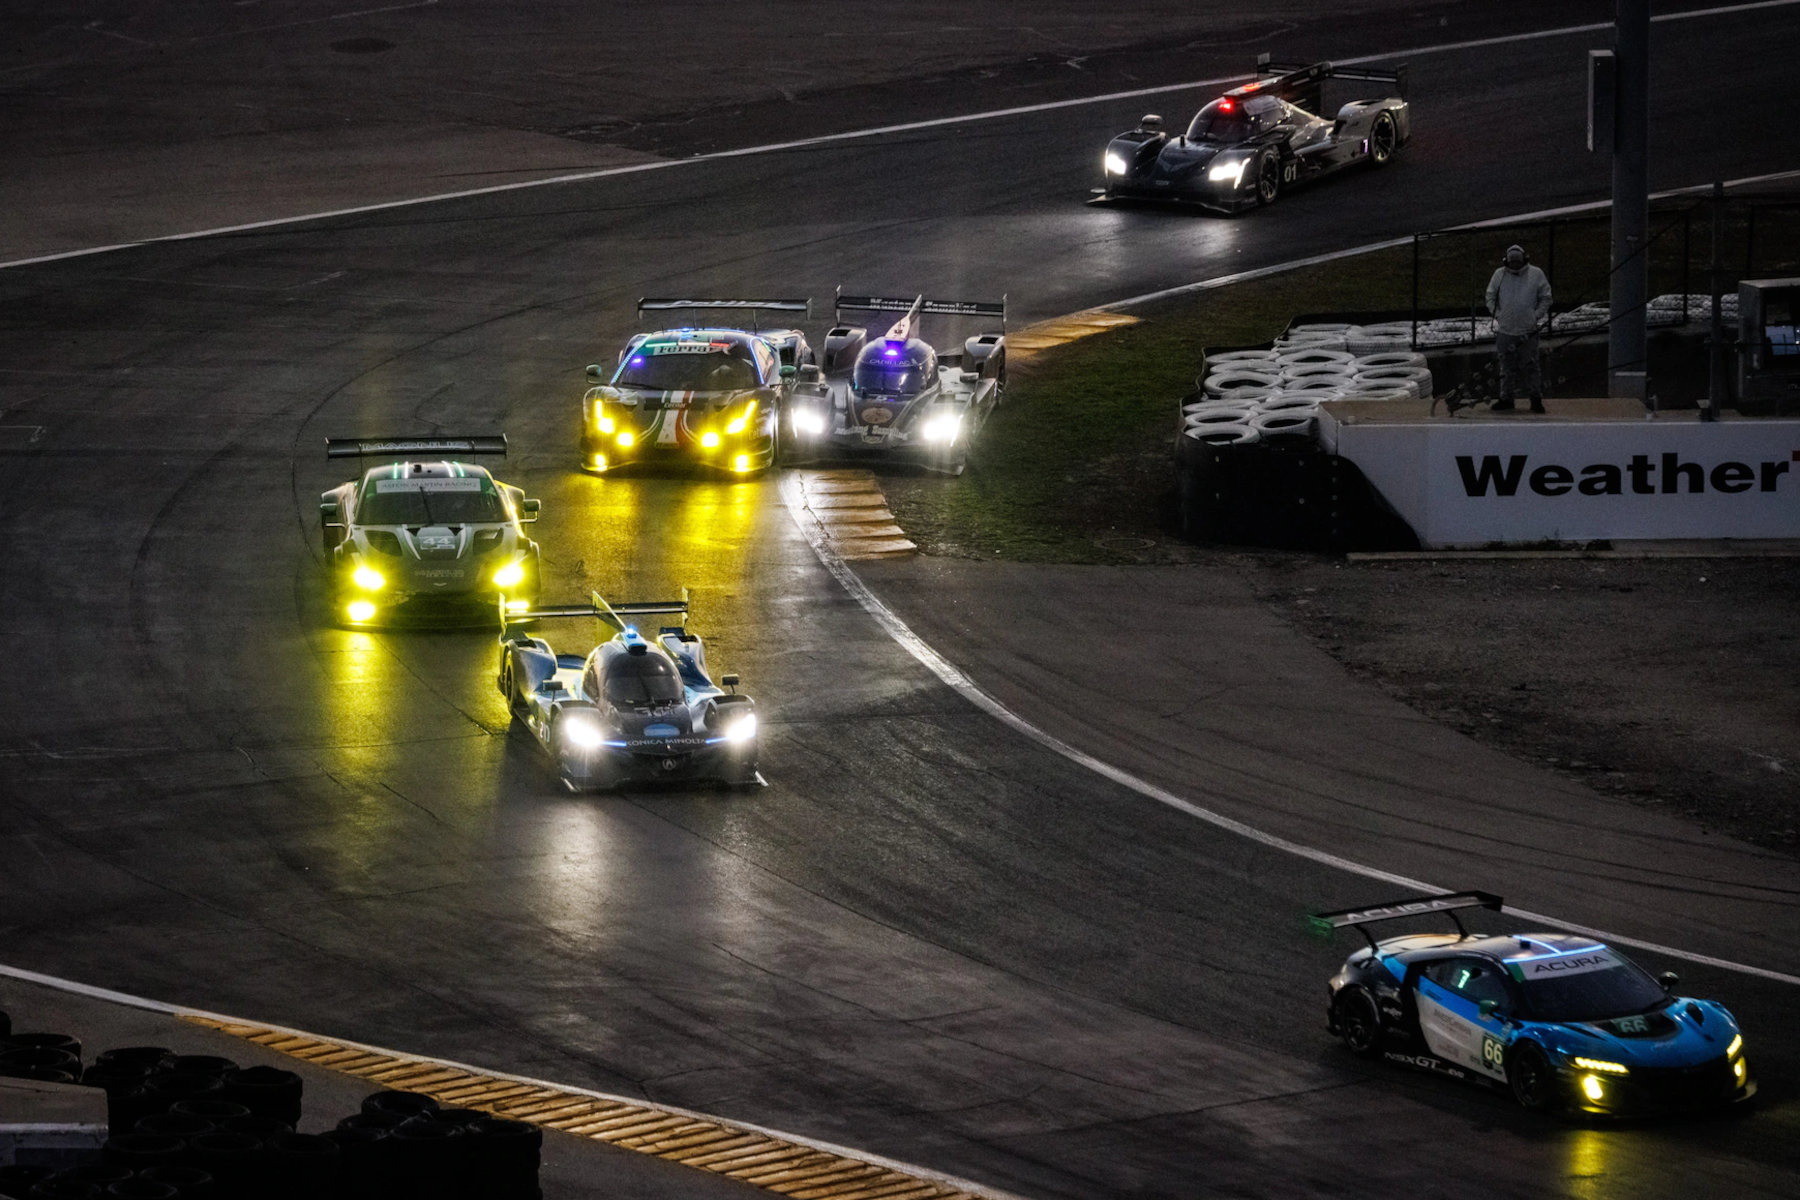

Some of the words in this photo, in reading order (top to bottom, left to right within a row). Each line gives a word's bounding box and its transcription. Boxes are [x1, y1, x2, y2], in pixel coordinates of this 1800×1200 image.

[1284, 163, 1297, 183] 01
[869, 359, 910, 367] CADILLAC
[1455, 450, 1800, 497] Weather
[423, 538, 451, 546] 44
[1346, 899, 1450, 921] ACURA
[1534, 955, 1609, 973] ACURA
[1484, 1038, 1503, 1065] 66
